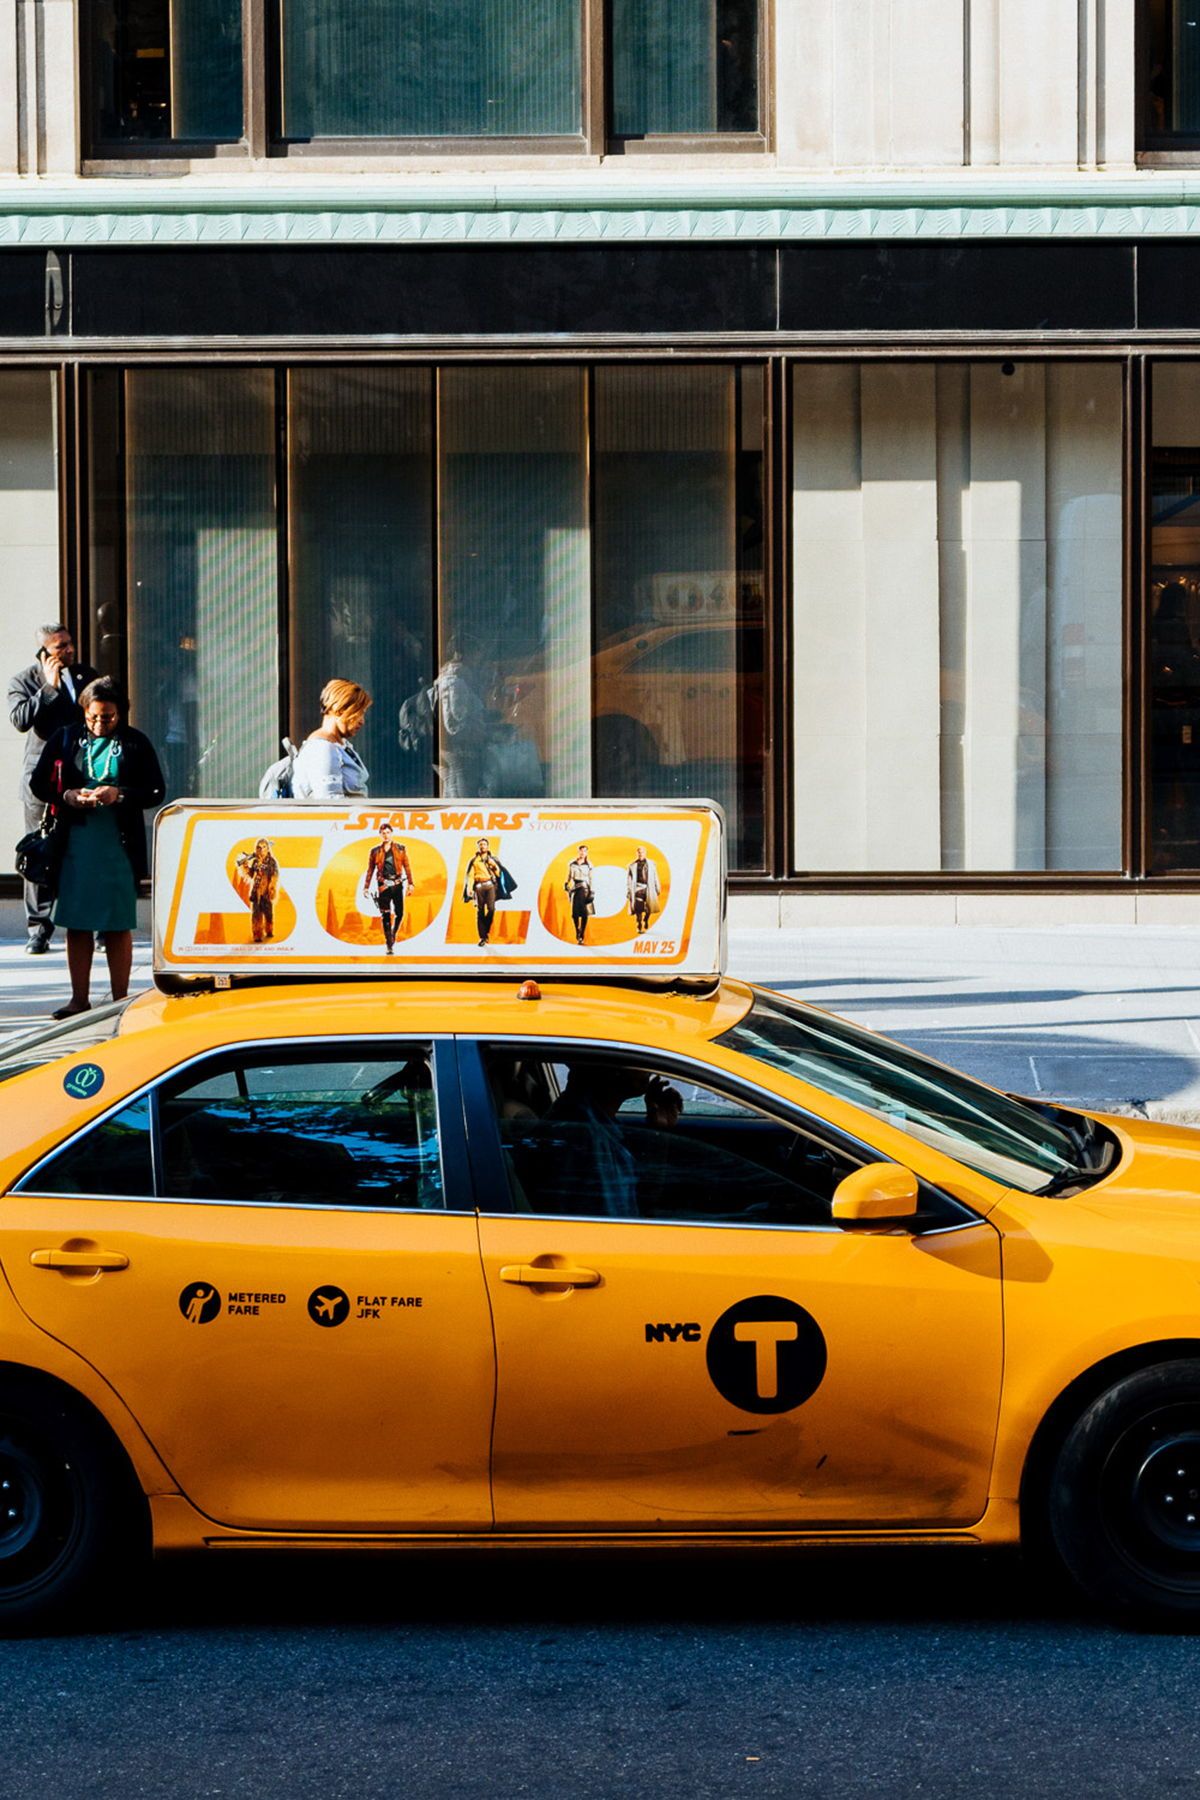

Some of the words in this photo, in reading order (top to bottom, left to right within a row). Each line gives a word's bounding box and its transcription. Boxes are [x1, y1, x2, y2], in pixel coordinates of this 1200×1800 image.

[330, 822, 338, 831] A
[344, 812, 435, 831] STAR
[440, 812, 530, 831] WARS
[529, 821, 570, 831] STORY
[194, 836, 672, 946] SOLO
[633, 941, 658, 954] MAY
[660, 941, 675, 954] 25
[228, 1292, 287, 1304] METERED
[357, 1296, 387, 1307] FLAT
[391, 1297, 423, 1308] FARE
[228, 1305, 260, 1316] FARE
[356, 1308, 381, 1319] JFK
[645, 1323, 702, 1342] NYC
[734, 1321, 799, 1398] T
